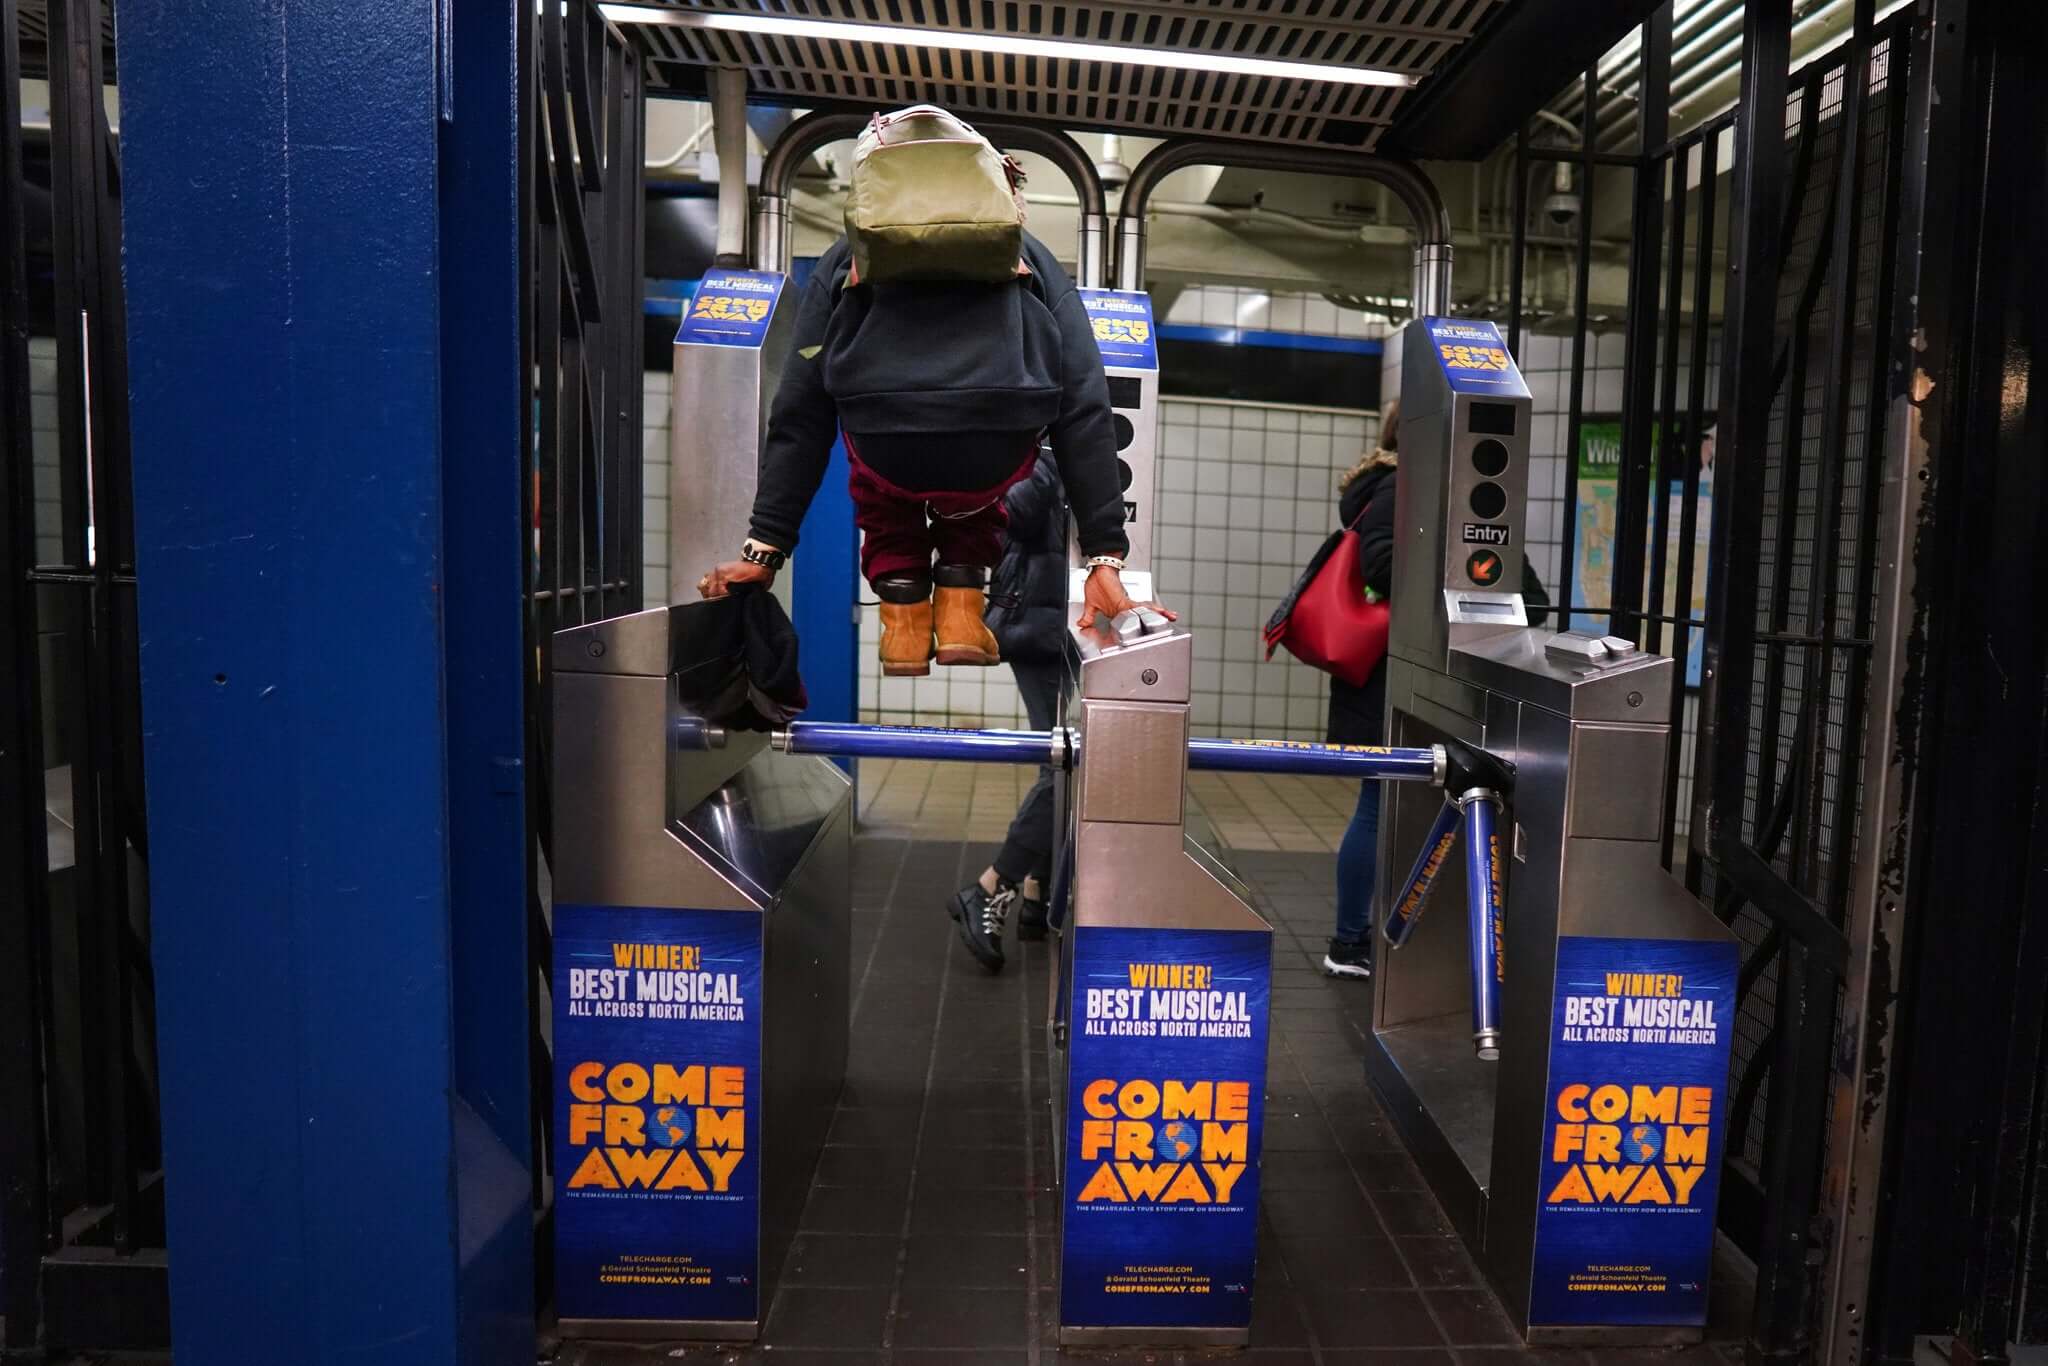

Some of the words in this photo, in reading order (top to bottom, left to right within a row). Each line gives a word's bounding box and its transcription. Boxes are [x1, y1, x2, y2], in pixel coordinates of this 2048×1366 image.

[699, 296, 770, 308] COME
[691, 311, 767, 322] AWAY
[1440, 345, 1504, 357] COME
[1447, 360, 1509, 371] AWAY
[1464, 525, 1507, 544] Entry
[613, 943, 701, 970] WINNER!
[569, 968, 629, 1000] BEST
[636, 971, 743, 1005] MUSICAL
[1129, 963, 1212, 989] WINNER!
[1606, 973, 1683, 997] WINNER!
[569, 1001, 592, 1016] ALL
[595, 1002, 644, 1018] ACROSS
[649, 1003, 686, 1020] NORTH
[690, 1004, 744, 1021] AMERICA
[1087, 989, 1143, 1019] BEST
[1150, 990, 1251, 1022] MUSICAL
[1565, 997, 1619, 1026] BEST
[1623, 998, 1717, 1029] MUSICAL
[1085, 1020, 1107, 1036] ALL
[1110, 1020, 1157, 1036] ACROSS
[1161, 1021, 1196, 1037] NORTH
[1200, 1023, 1251, 1038] AMERICA
[1563, 1027, 1582, 1042] ALL
[1585, 1027, 1629, 1042] ACROSS
[1633, 1028, 1666, 1043] NORTH
[1668, 1030, 1716, 1045] AMERICA
[569, 1061, 745, 1107] COME
[1083, 1079, 1250, 1121] COME
[1557, 1083, 1712, 1125] COME
[567, 1147, 744, 1192] AWAY
[1077, 1161, 1247, 1203] AWAY
[1547, 1163, 1706, 1205] AWAY
[620, 1255, 692, 1263] TELECHARGE.COM
[600, 1275, 711, 1285] COMEFROMAWAY.COM
[1104, 1285, 1210, 1293] COMEFROMAWAY.COM
[1568, 1284, 1666, 1292] COMEFROMAWAY.COM
